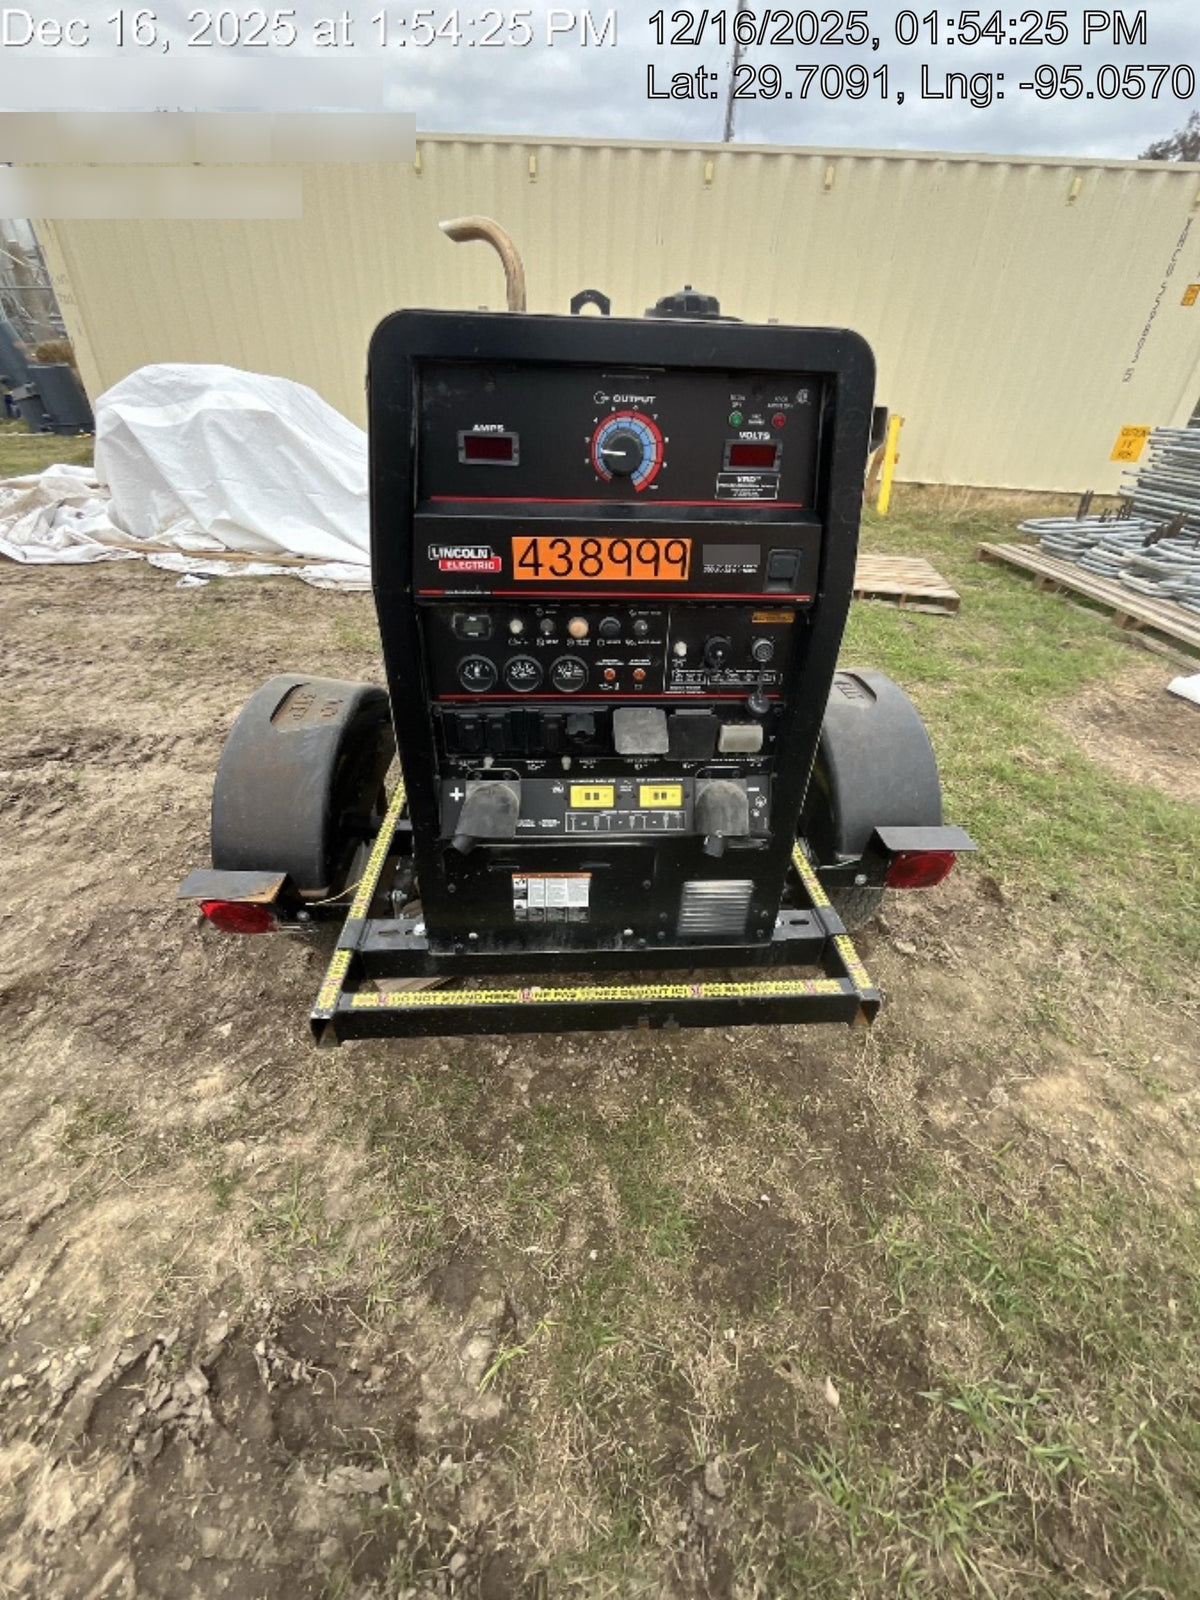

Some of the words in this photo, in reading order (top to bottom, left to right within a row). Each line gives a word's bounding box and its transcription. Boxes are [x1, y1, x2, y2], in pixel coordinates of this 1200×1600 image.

[613, 393, 656, 403] OUTPUT
[472, 424, 504, 433] AMPS
[739, 431, 770, 440] VOLTS
[431, 547, 488, 559] LINCOLN
[518, 538, 689, 577] 438999
[447, 560, 495, 570] ELECTRIC
